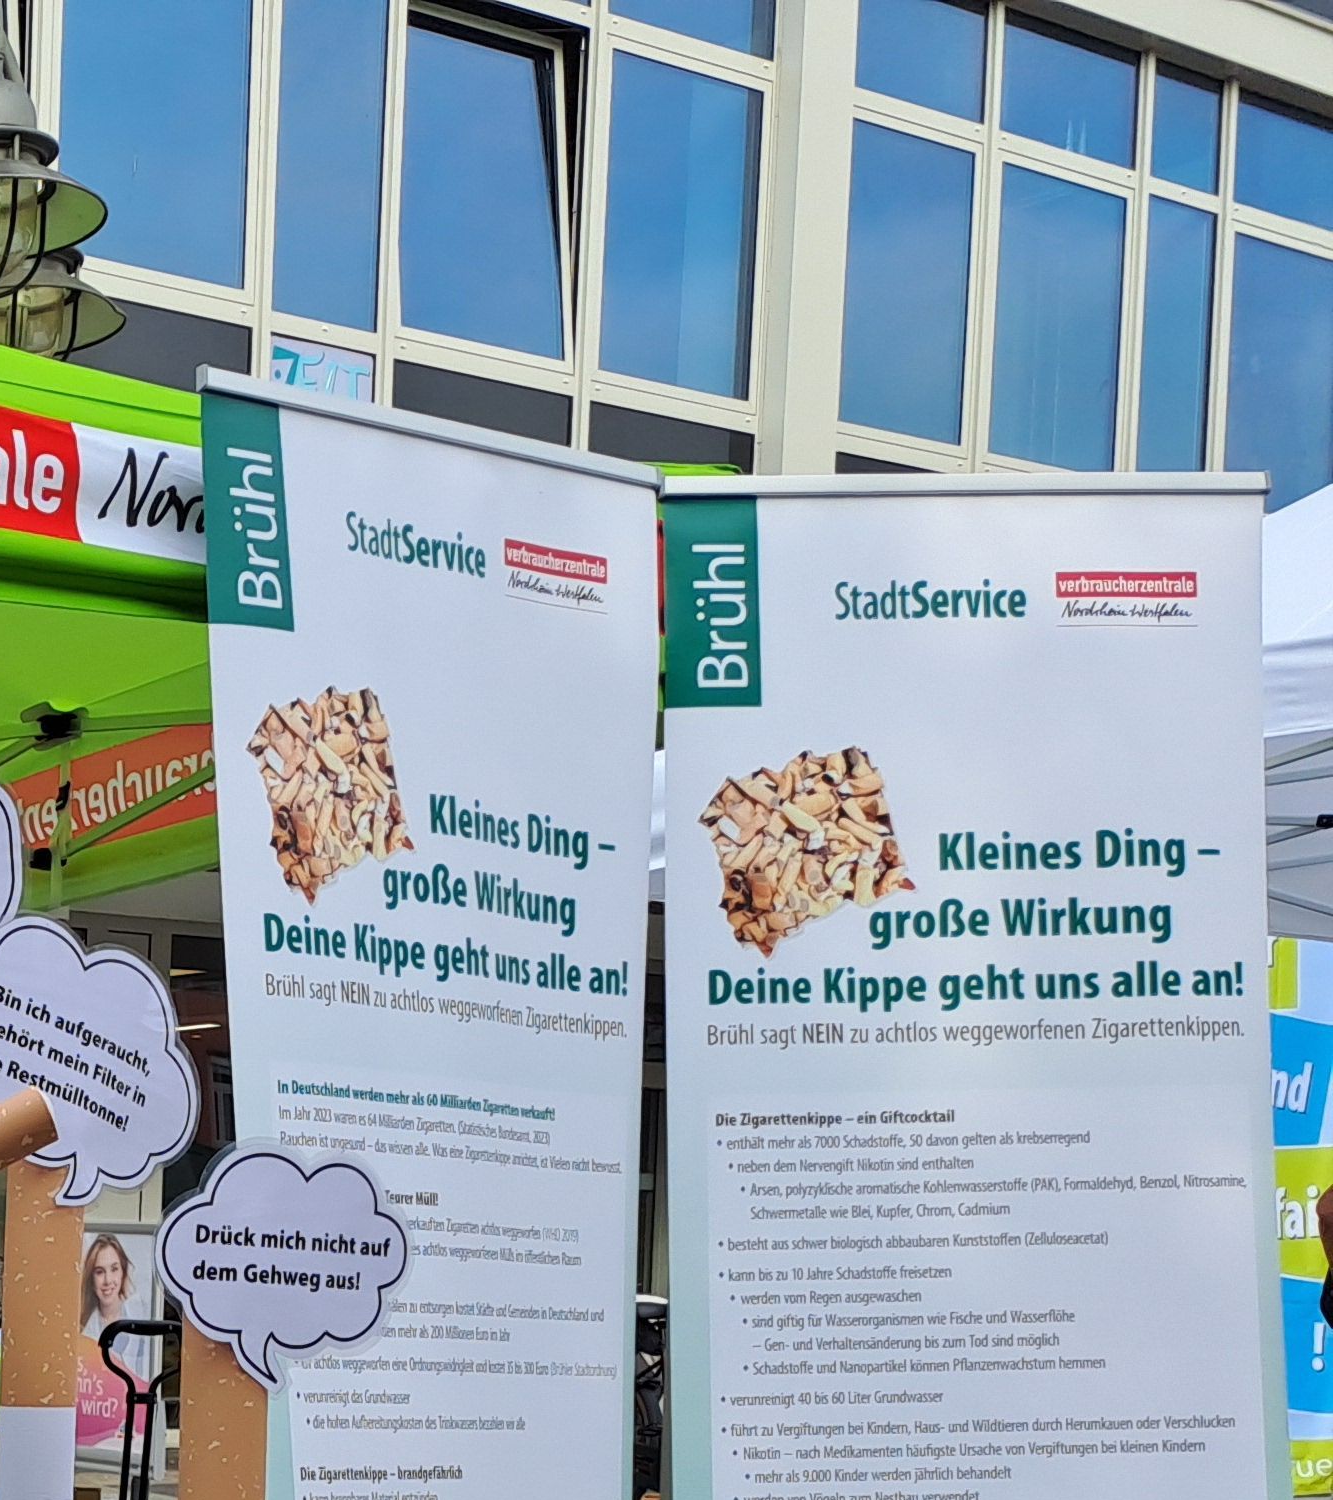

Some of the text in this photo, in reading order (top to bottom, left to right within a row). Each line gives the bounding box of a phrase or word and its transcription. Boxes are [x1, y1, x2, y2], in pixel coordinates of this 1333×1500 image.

[227, 447, 283, 610] Brühl
[346, 510, 486, 579] StadtService
[506, 545, 606, 578] verbraucherzentrale
[1058, 576, 1194, 593] verbraucherzentrale
[691, 543, 749, 689] Brühl
[834, 578, 1027, 621] StadtService
[429, 793, 588, 870] Kleines Ding
[938, 827, 1185, 877] Kleines Ding
[383, 863, 575, 937] große Wirkung
[869, 896, 1171, 949] große Wirkung
[263, 912, 627, 996] Deine Kippe geht uns alle an!
[708, 960, 1242, 1012] Deine Kippe geht uns alle an!
[715, 1109, 954, 1129] Die Zigarettenkippe ein Giftcocktail
[195, 1224, 391, 1258] Drück mich nicht auf
[192, 1259, 360, 1292] dem Gehweg aus!
[728, 1264, 952, 1281] kann bis zu 10 Jahre Schadstoffe freisetzen
